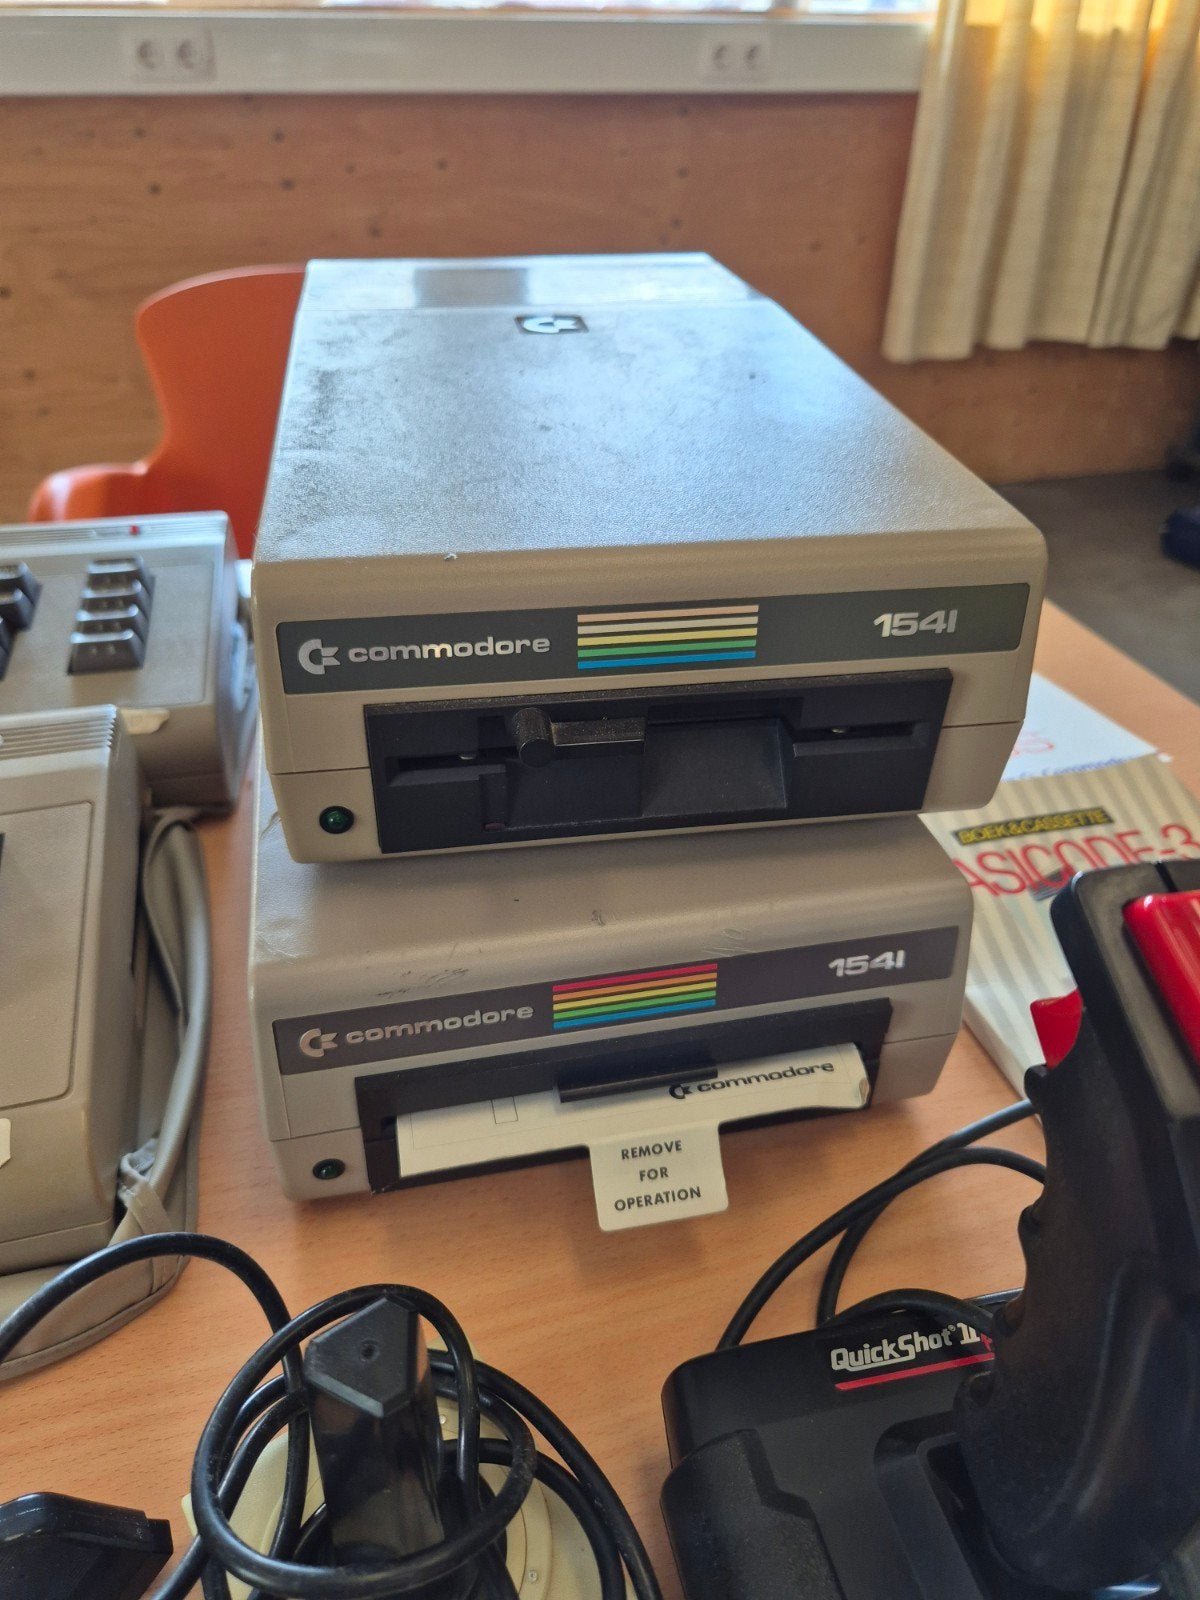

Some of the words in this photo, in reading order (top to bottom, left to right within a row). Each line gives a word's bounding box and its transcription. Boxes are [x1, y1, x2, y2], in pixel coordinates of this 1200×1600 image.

[873, 609, 958, 638] 1541
[348, 636, 551, 663] commodore
[828, 949, 905, 977] 1541
[346, 1006, 534, 1043] commodore
[697, 1062, 835, 1093] commodore
[621, 1139, 683, 1161] REMOVE
[639, 1166, 669, 1182] FOR
[613, 1186, 702, 1211] OPERATION
